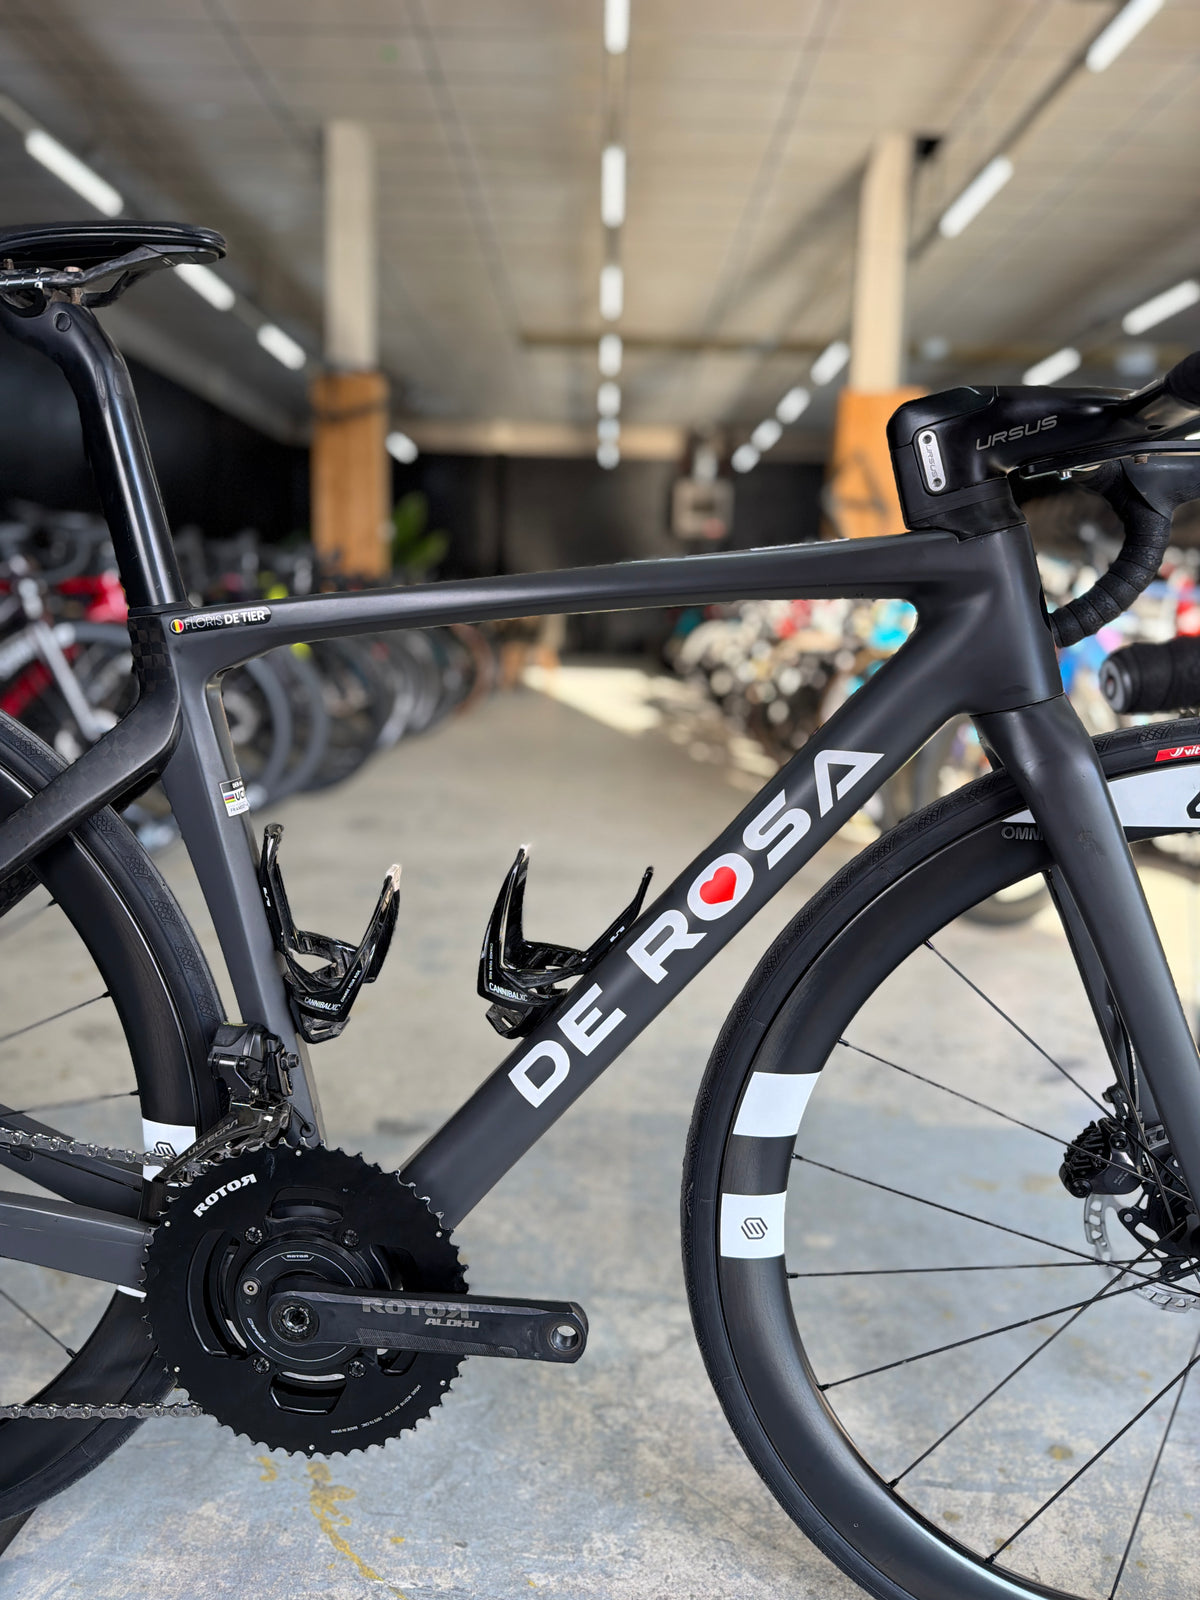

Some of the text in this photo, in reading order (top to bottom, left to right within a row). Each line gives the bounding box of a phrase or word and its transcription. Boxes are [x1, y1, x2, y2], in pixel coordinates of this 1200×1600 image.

[975, 415, 1058, 451] URSUS
[925, 444, 939, 478] URSUS
[185, 610, 266, 630] FLORIS DE TIER
[507, 749, 885, 1109] DE ROSA
[188, 1119, 239, 1156] ULTEGRA
[193, 1173, 258, 1218] ROTOR
[361, 1299, 470, 1319] ROTOR
[424, 1318, 481, 1329] ALDHU
